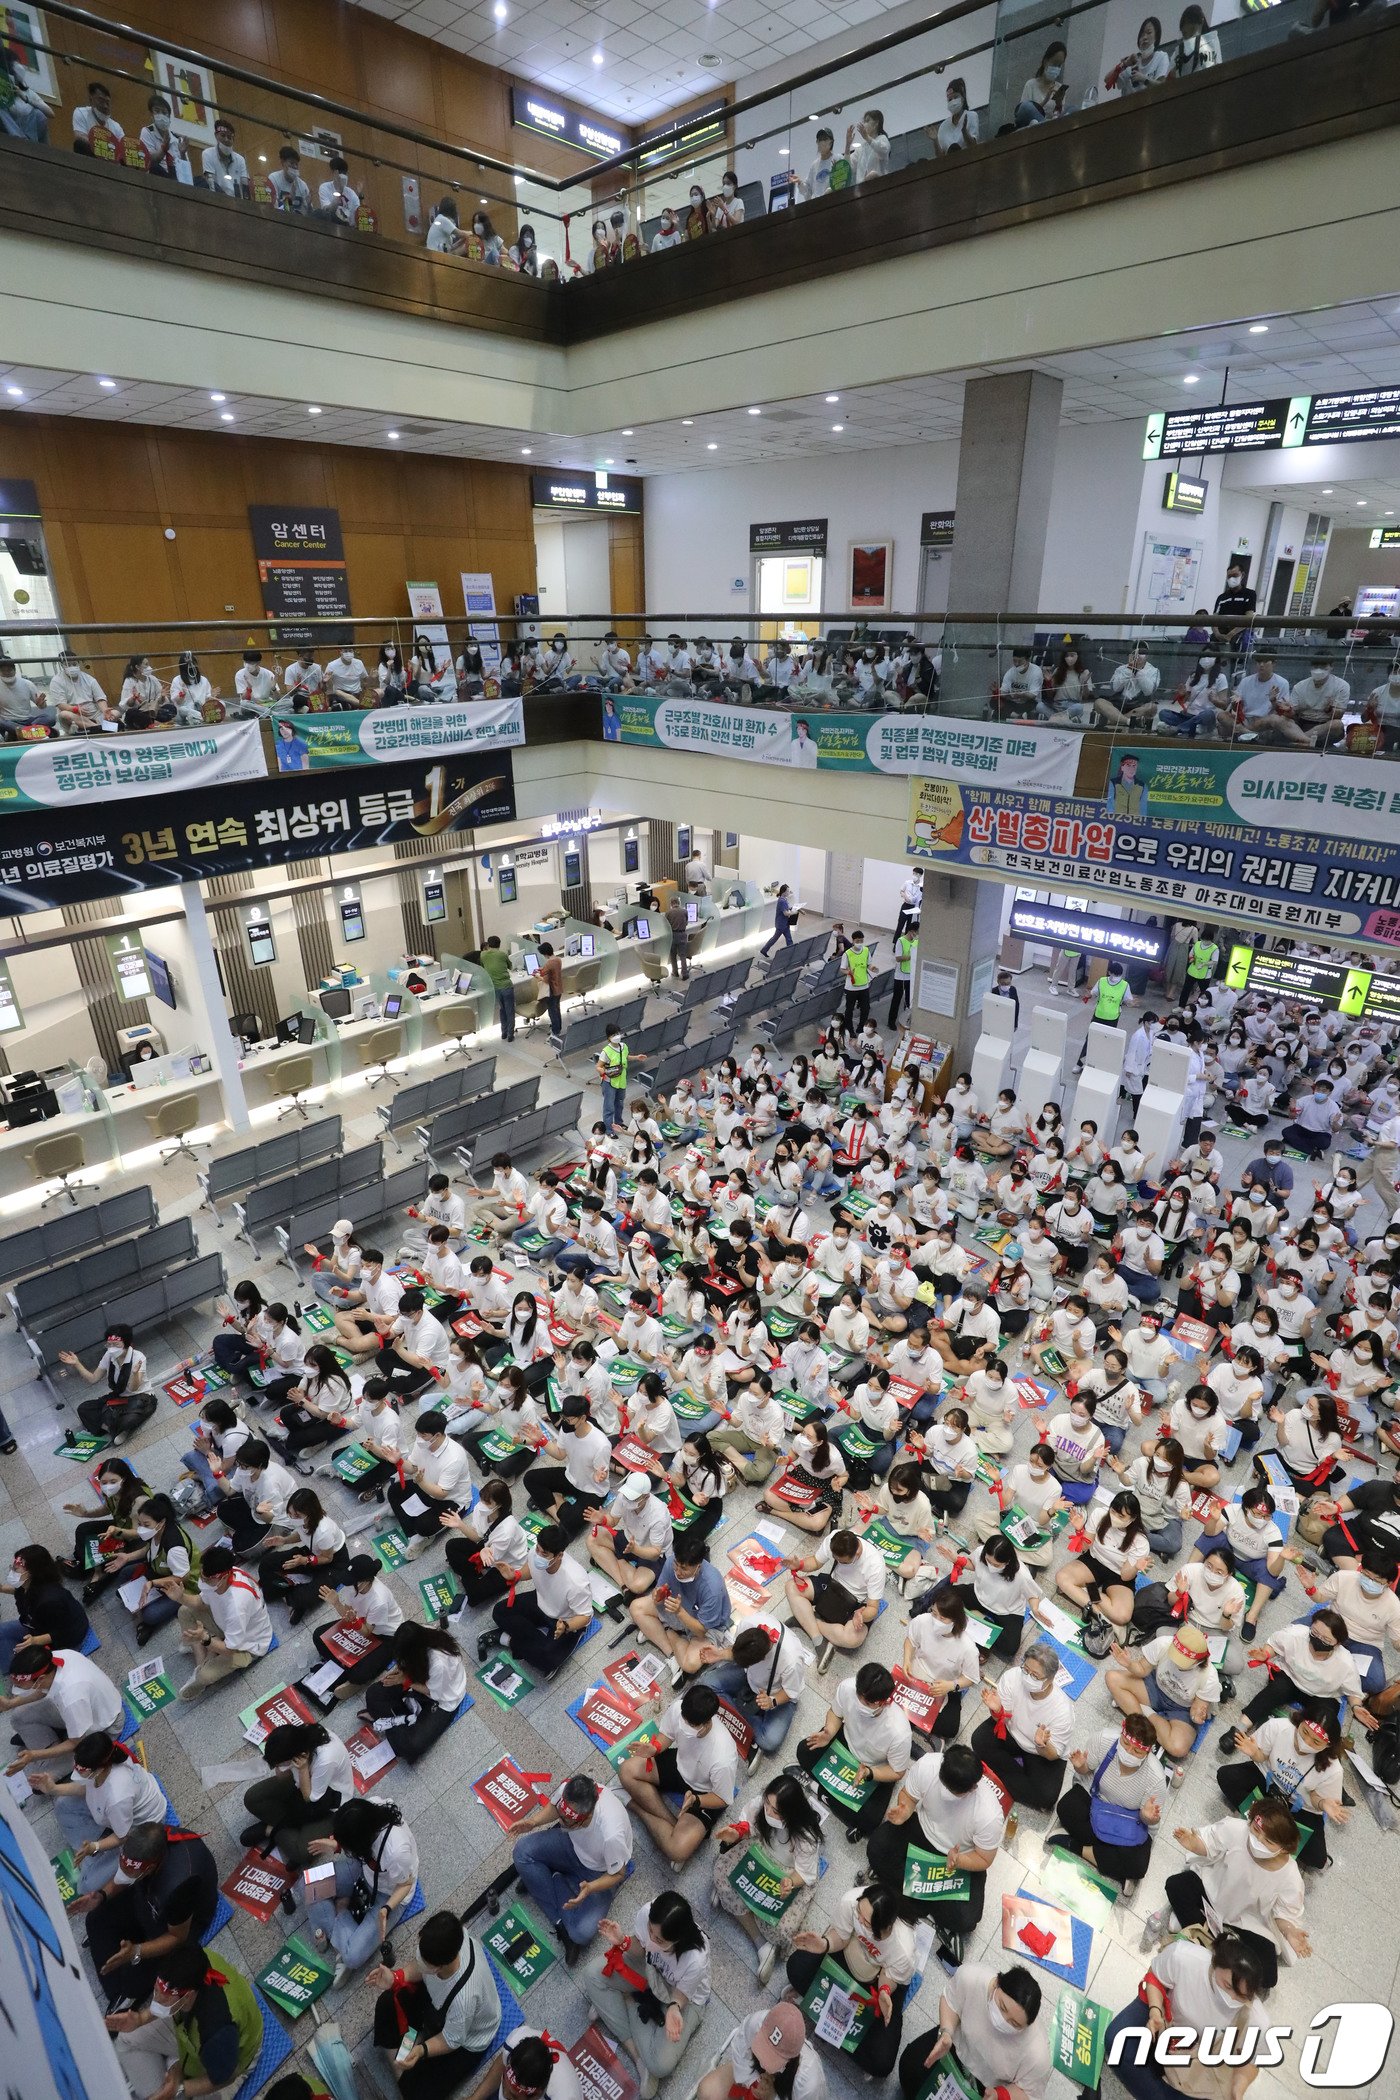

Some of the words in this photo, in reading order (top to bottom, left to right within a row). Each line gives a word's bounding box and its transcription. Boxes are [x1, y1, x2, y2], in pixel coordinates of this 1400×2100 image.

[274, 540, 301, 549] Cancer
[302, 540, 327, 549] Center
[372, 718, 407, 735] 간병비
[409, 716, 443, 732] 해결을
[445, 713, 468, 728] 위한
[374, 730, 474, 751] 간호간병통합서비스
[475, 726, 497, 740] 전면
[498, 721, 521, 737] 확대!
[664, 709, 700, 725] 근무조별
[702, 713, 732, 730] 간호사
[733, 716, 744, 732] 대
[745, 718, 767, 735] 환자
[768, 722, 778, 736] 수
[666, 724, 690, 738] 1:5로
[691, 726, 710, 741] 환자
[710, 728, 731, 743] 안전
[732, 732, 756, 749] 보장!
[881, 726, 919, 743] 직종별
[920, 728, 1004, 752] 적정인력기준
[1005, 740, 1037, 759] 마련
[52, 748, 133, 773] 코로나19
[134, 738, 218, 764] 영웅들에게
[880, 745, 893, 761] 및
[895, 745, 920, 762] 업무
[921, 746, 949, 765] 범위
[950, 749, 999, 772] 명확화!
[56, 771, 112, 792] 정당한
[116, 762, 173, 785] 보상을!
[1156, 765, 1187, 773] 국민건강
[1187, 766, 1210, 775] 지키는
[448, 801, 464, 817] 전국
[1241, 779, 1328, 800] 의사인력
[1331, 784, 1384, 812] 확충!
[121, 826, 179, 866] 3년
[185, 817, 248, 855] 연속
[254, 798, 352, 846] 최상위
[358, 788, 415, 828] 등급
[627, 826, 634, 838] 4
[965, 790, 991, 804] "함께
[994, 791, 1024, 809] 싸우고
[1028, 797, 1051, 812] 함께
[1054, 802, 1096, 821] 승리하는
[1151, 817, 1200, 834] 노동개악
[1204, 822, 1260, 845] 막아내고!
[1265, 831, 1321, 855] 노동조건
[1323, 840, 1397, 862] 지켜내자!"
[54, 834, 108, 853] 보건복지부
[968, 805, 1159, 865] 산별총파업으로
[1165, 842, 1234, 879] 우리의
[1241, 854, 1319, 895] 권리를
[26, 850, 115, 882] 의료질평가
[501, 853, 510, 866] 6
[427, 870, 436, 884] 7
[343, 886, 354, 900] 8
[1005, 853, 1188, 899] 전국보건의료산업노동조합
[1195, 886, 1343, 930] 아주대의료원지부
[250, 907, 261, 922] 9
[119, 935, 131, 951] 1
[1109, 932, 1160, 956] 무인수납
[860, 1039, 875, 1051] Lee
[1177, 1326, 1208, 1343] 미래없다!
[1182, 1320, 1209, 1335] 투쟁없이
[332, 1632, 367, 1656] 미래없다!
[143, 1679, 167, 1700] 승리!!
[611, 1668, 642, 1700] 투쟁없이
[894, 1680, 935, 1707] 미래없다!
[590, 1700, 632, 1727] 미래없다!
[892, 1691, 929, 1718] 투쟁없이
[586, 1708, 623, 1735] 투쟁없이
[484, 1780, 523, 1814] 미래없다!
[496, 1771, 530, 1802] 투쟁없이
[819, 1767, 866, 1800] 산별총파업
[232, 1879, 273, 1904] 투쟁없이
[239, 1865, 285, 1891] 미래없다!
[754, 1873, 784, 1897] 승리!!
[911, 1879, 965, 1894] 산별총파업
[735, 1874, 785, 1912] 산별총파업
[264, 1970, 313, 2003] 산별총파업
[287, 1962, 321, 1987] 승리!!
[769, 2026, 784, 2042] B
[1058, 1988, 1079, 2069] 산별총파업
[1077, 2026, 1092, 2067] 승리!!
[576, 2048, 625, 2100] 미래없다!
